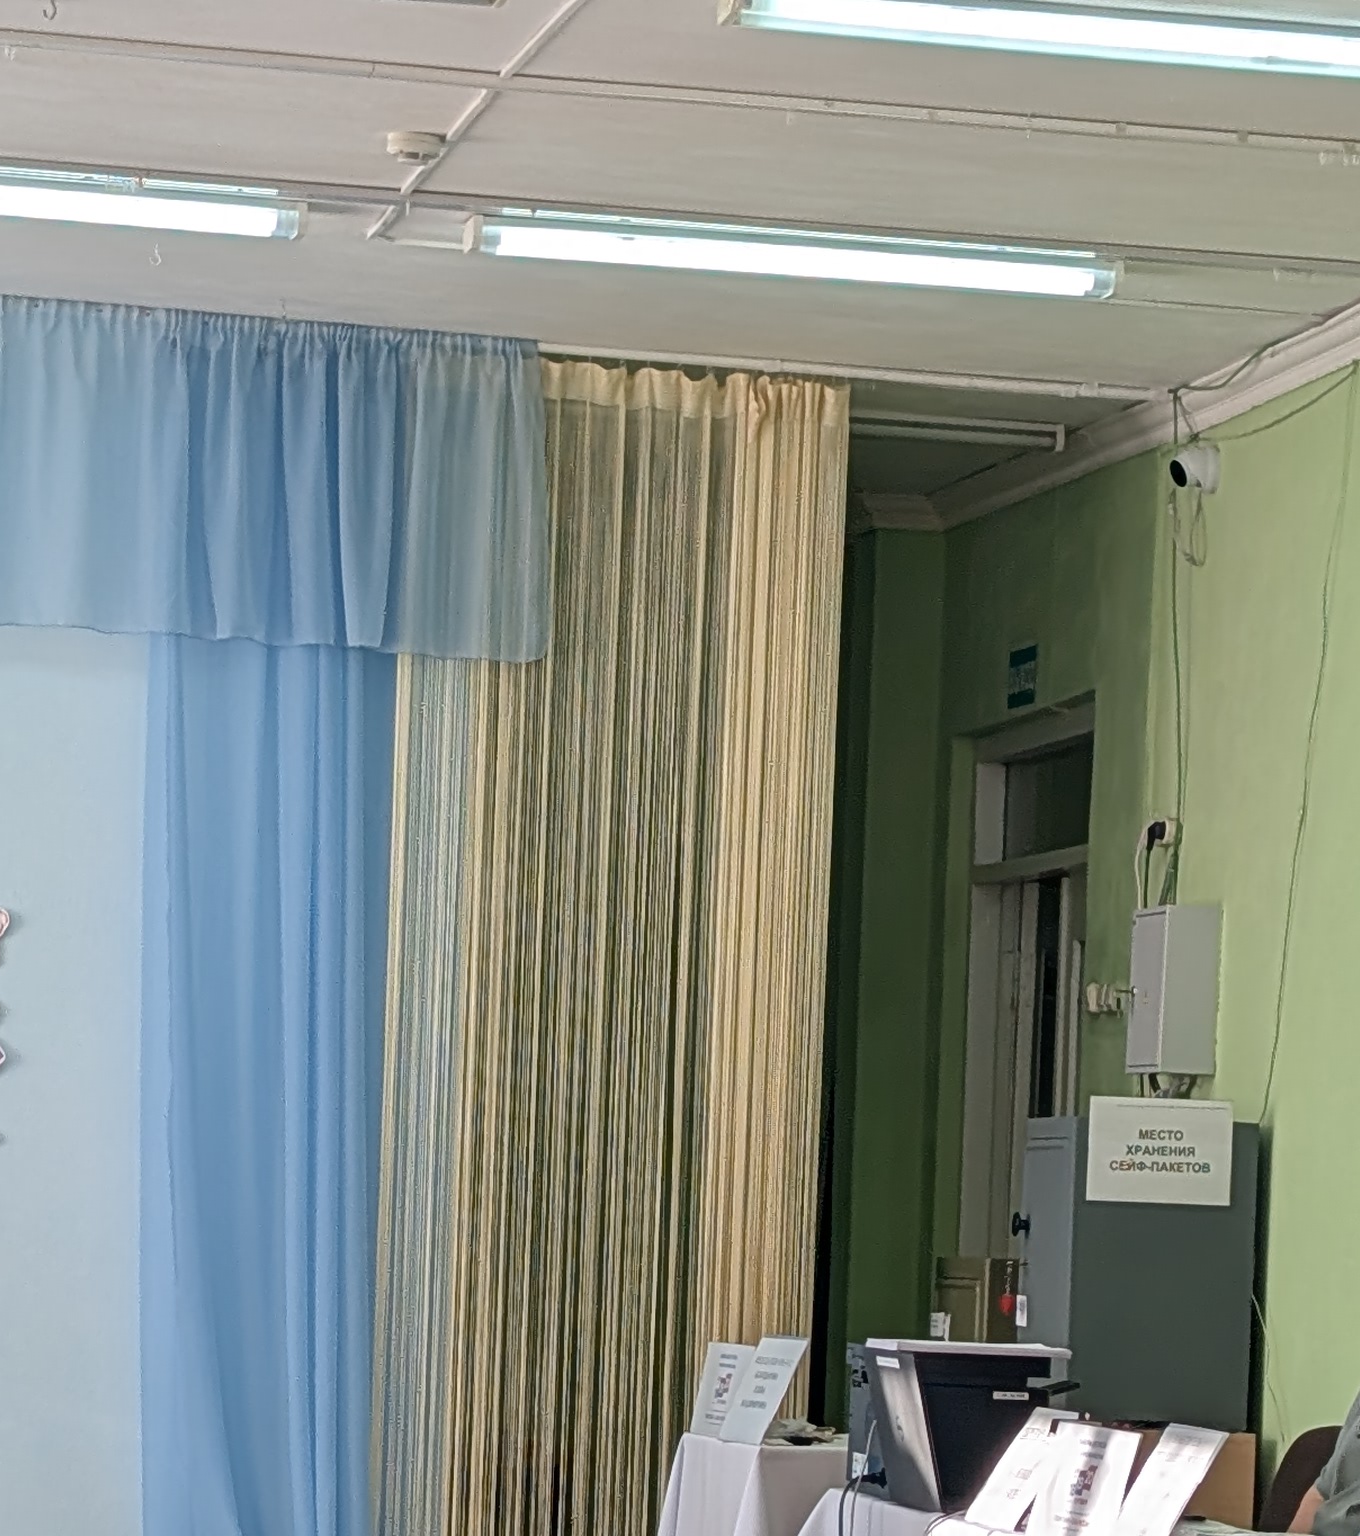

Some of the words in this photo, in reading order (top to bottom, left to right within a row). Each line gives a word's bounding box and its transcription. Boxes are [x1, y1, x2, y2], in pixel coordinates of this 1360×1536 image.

[1138, 1128, 1184, 1142] МЕСТО
[1125, 1144, 1196, 1158] ХРАНЕНИЯ
[1109, 1159, 1211, 1174] СЕЙФ-ПАКЕТОВ
